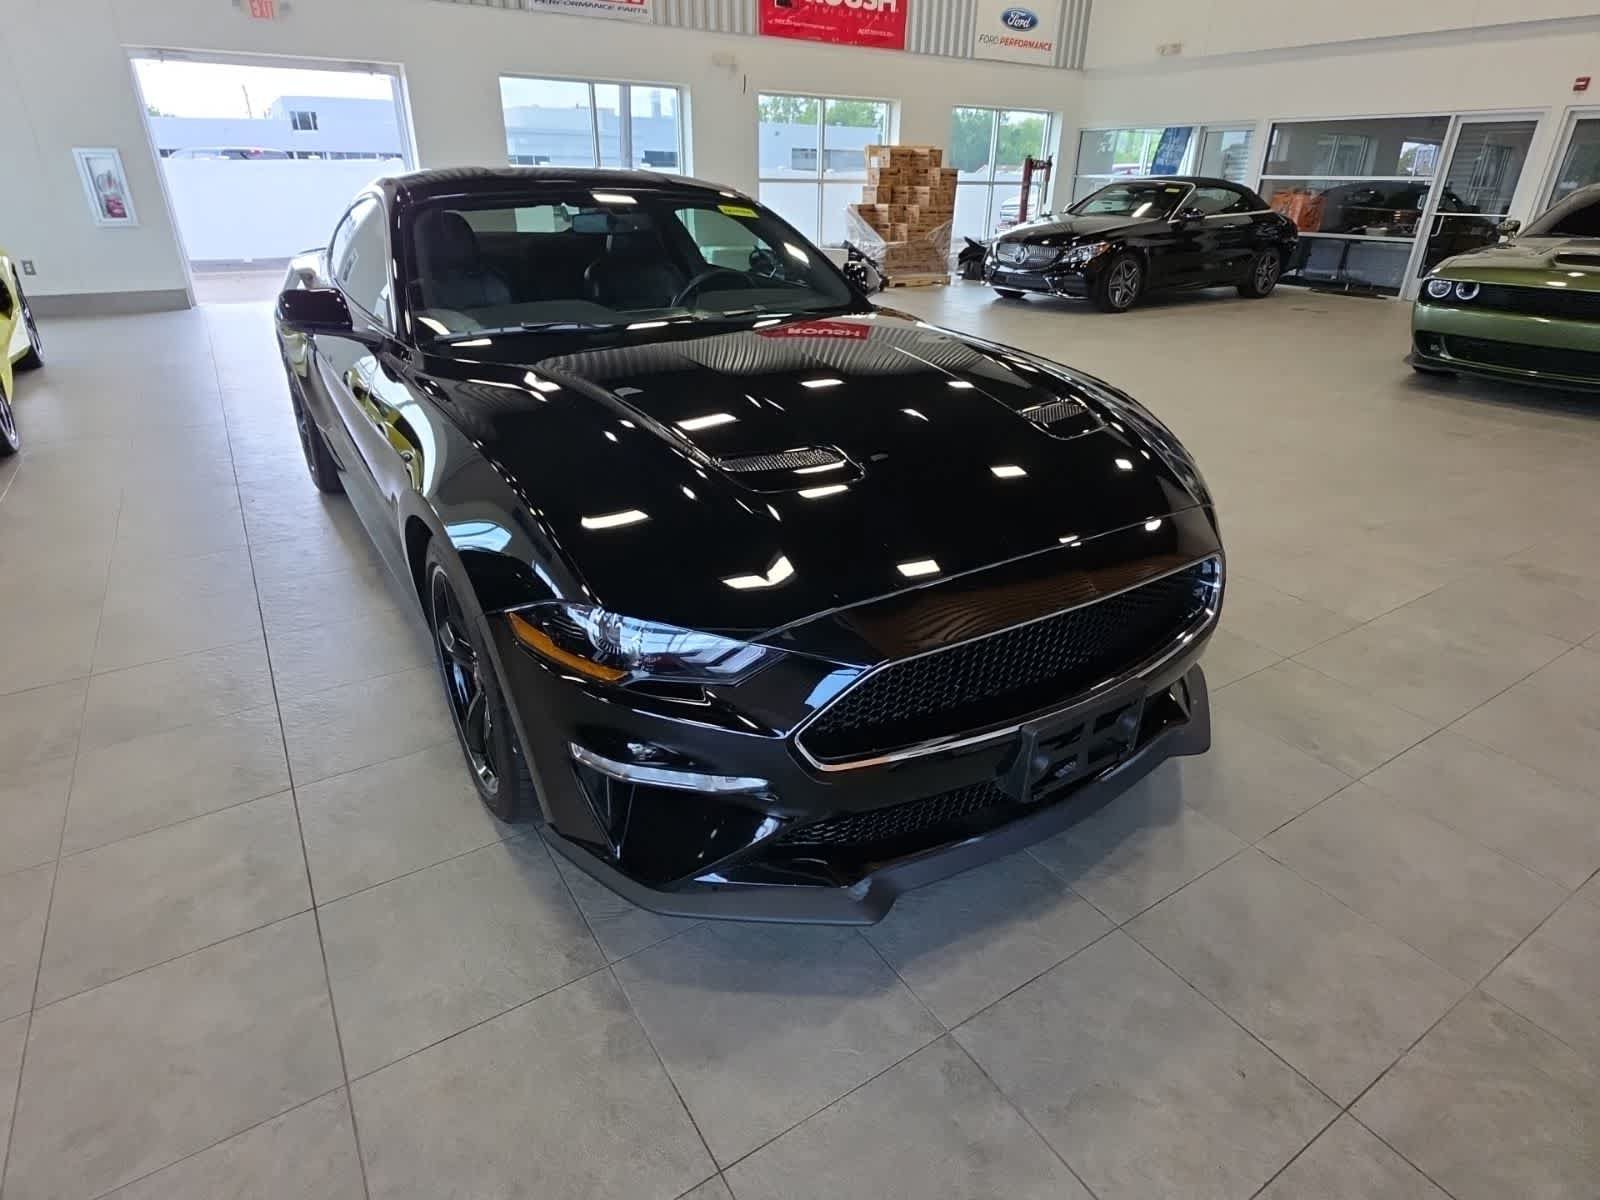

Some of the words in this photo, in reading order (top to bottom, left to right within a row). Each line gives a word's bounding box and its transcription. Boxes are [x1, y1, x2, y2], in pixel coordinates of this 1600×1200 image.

[249, 0, 274, 17] EXIT
[1008, 11, 1032, 28] Ford
[1000, 37, 1052, 51] PERFORMANCE
